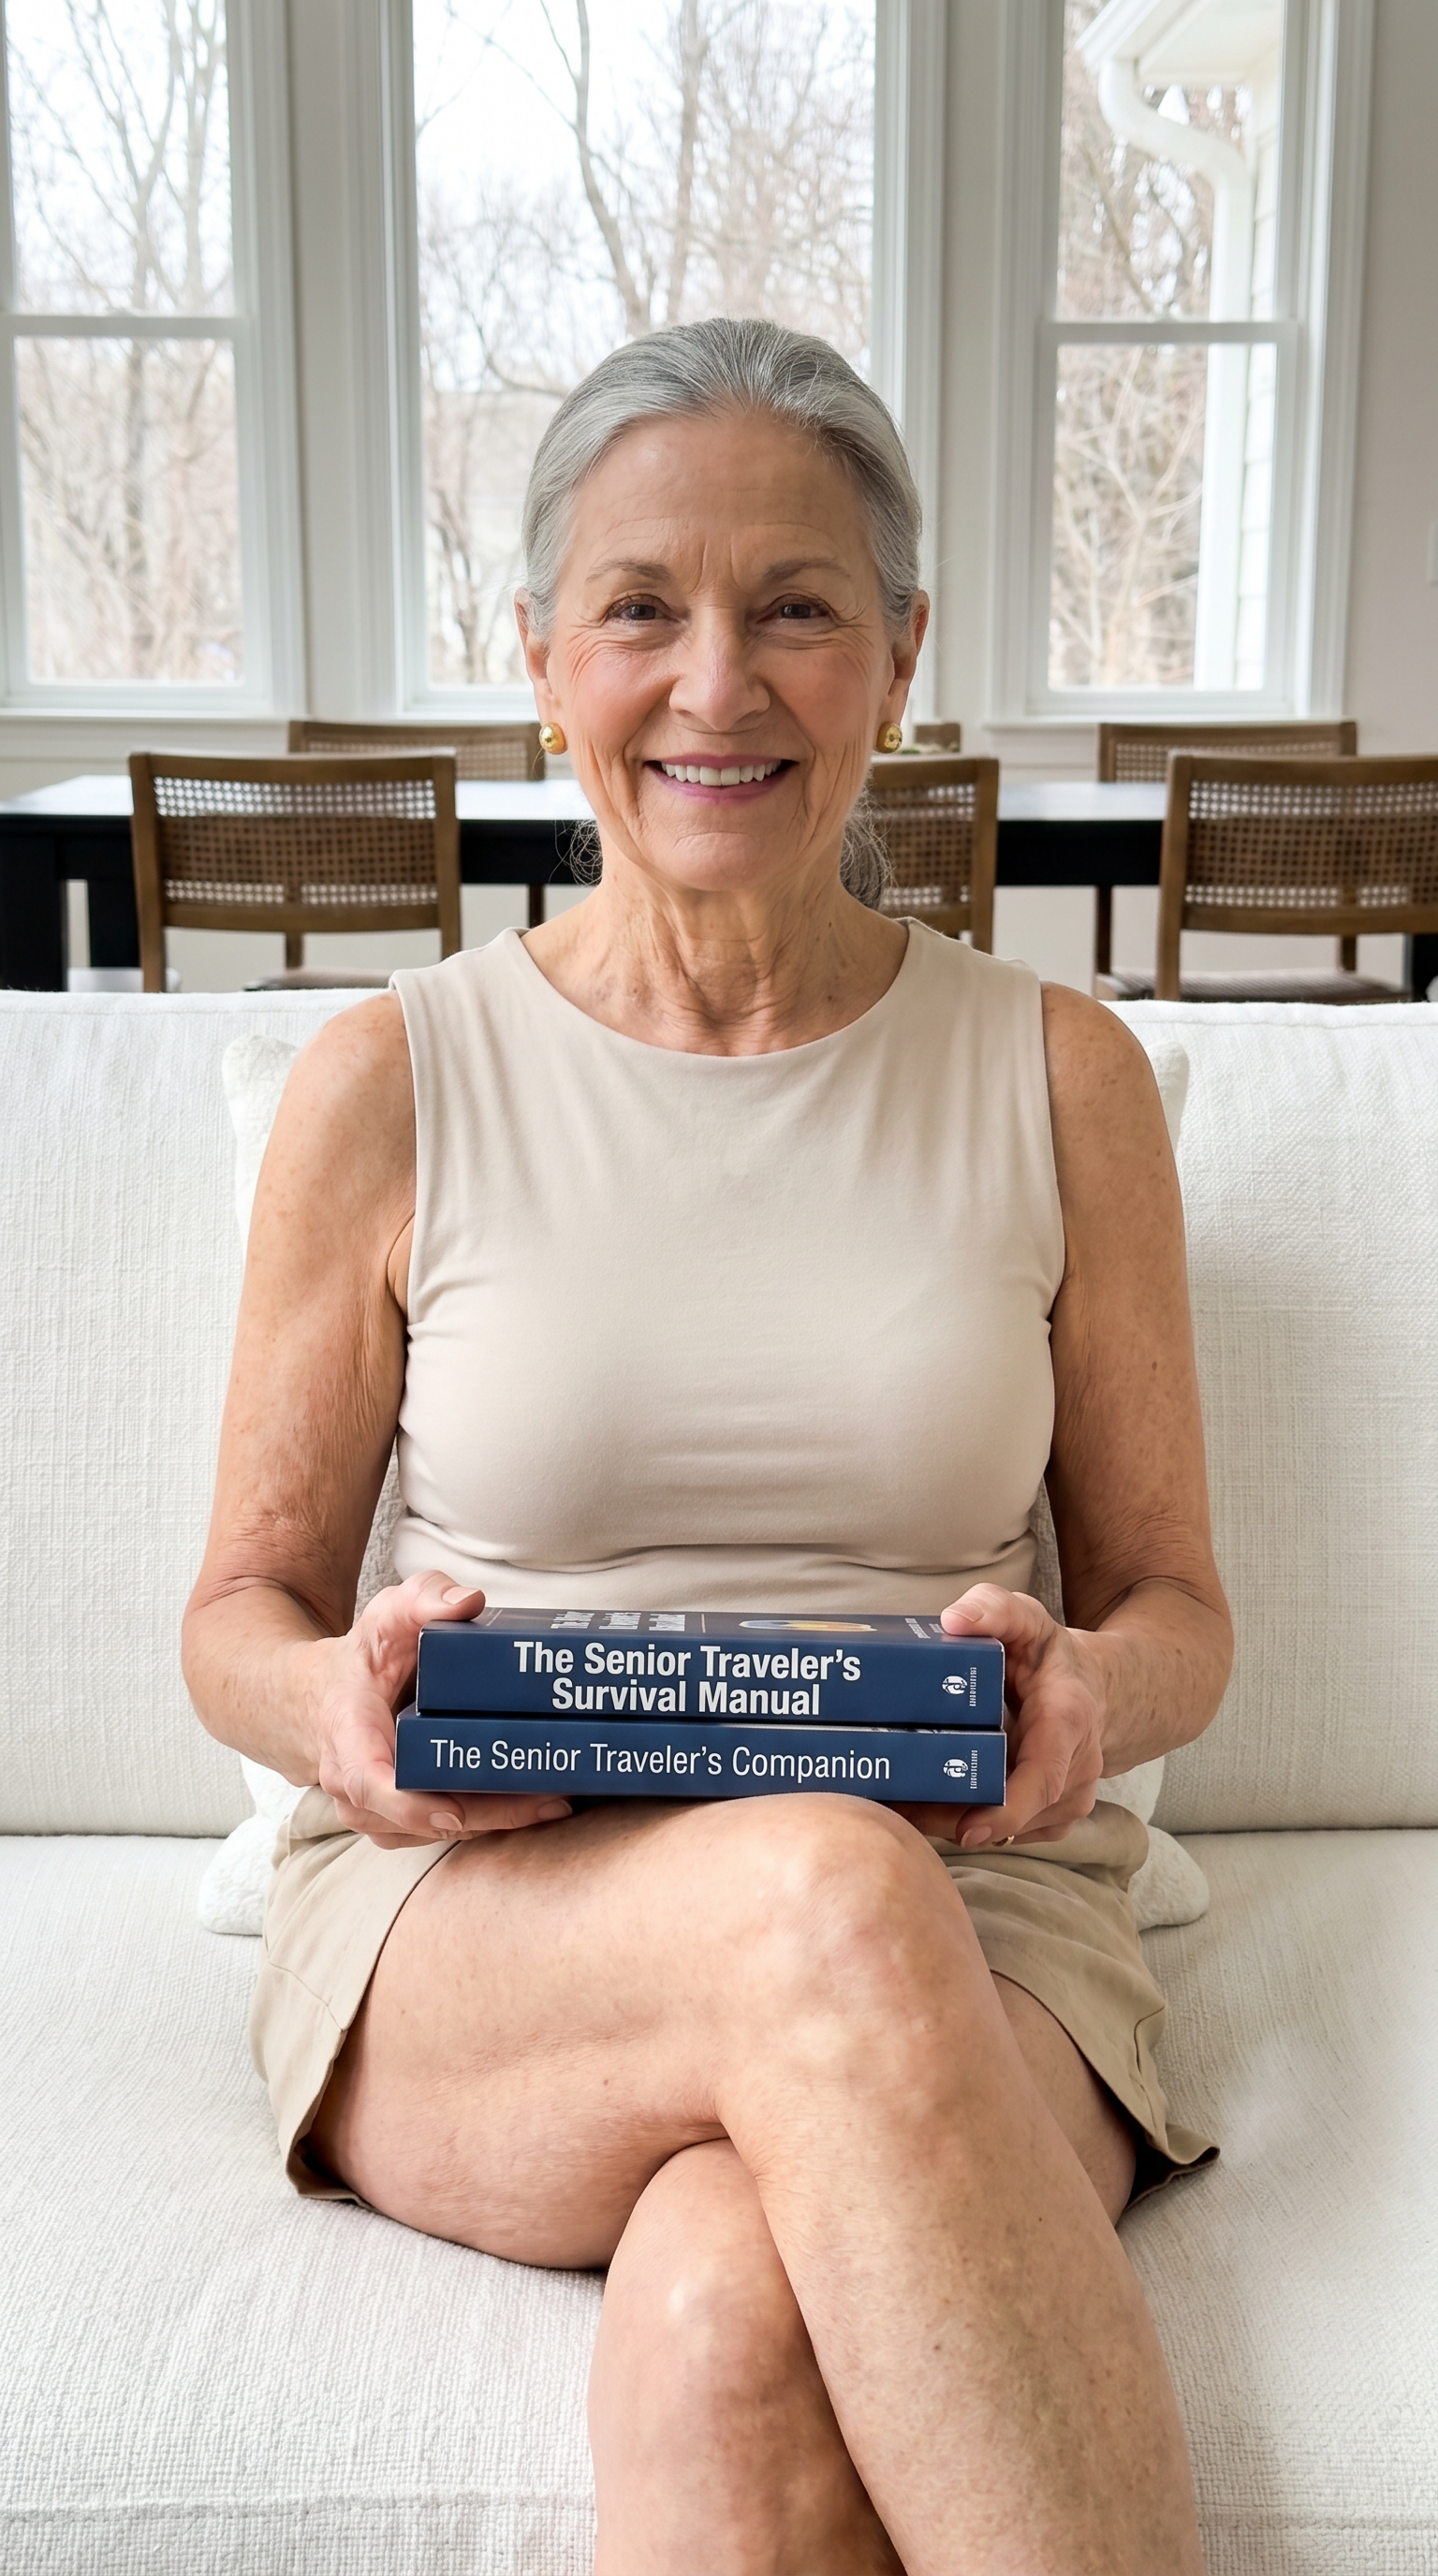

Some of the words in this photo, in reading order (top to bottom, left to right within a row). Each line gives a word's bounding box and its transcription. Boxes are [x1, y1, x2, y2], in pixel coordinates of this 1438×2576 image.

[513, 1641, 574, 1674] The
[584, 1642, 692, 1676] Senior
[699, 1645, 861, 1681] Traveler's
[551, 1676, 686, 1712] Survival
[698, 1680, 820, 1716] Manual
[430, 1739, 481, 1769] The
[491, 1740, 582, 1771] Senior
[589, 1743, 723, 1776] Traveler's
[732, 1746, 890, 1784] Companion
